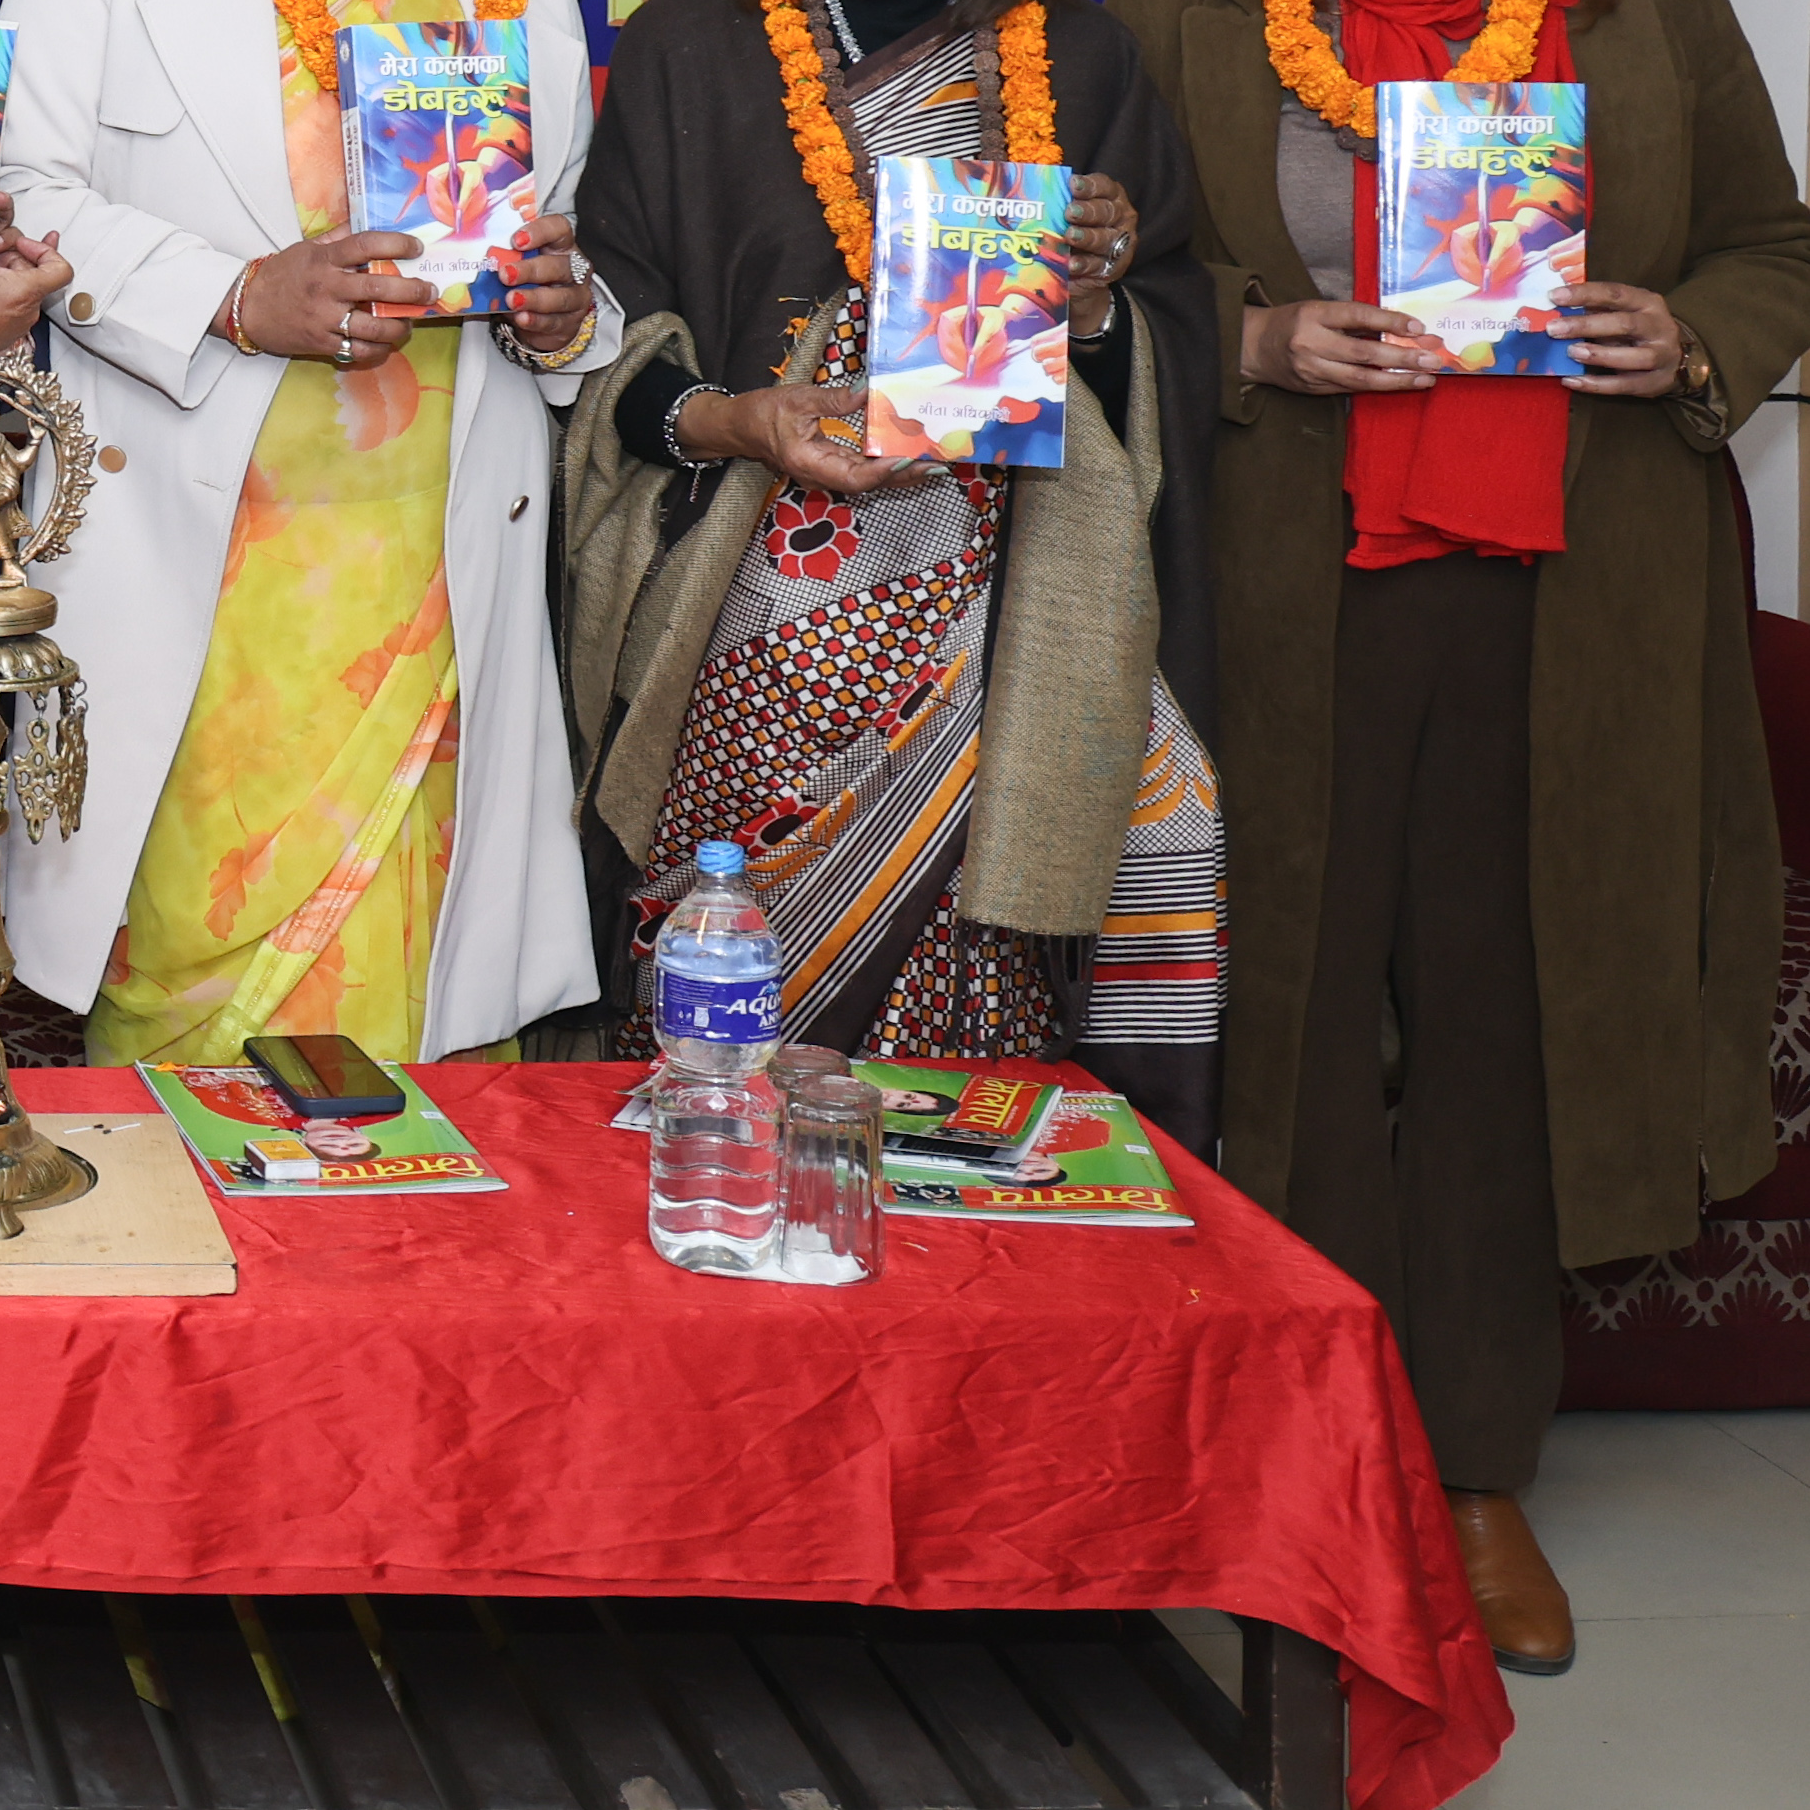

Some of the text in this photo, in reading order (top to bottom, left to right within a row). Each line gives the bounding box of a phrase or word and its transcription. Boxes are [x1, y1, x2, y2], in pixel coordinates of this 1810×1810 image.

[380, 52, 507, 77] मेरा कलमका
[383, 80, 509, 118] डोबहरू
[1457, 115, 1556, 136] कलमका
[1409, 140, 1556, 179] डोबहरू
[951, 193, 1045, 221] कलमका
[900, 218, 1044, 265] डोबहरू
[419, 258, 444, 272] गीता
[1436, 317, 1465, 331] गीता
[918, 403, 946, 417] गीता
[983, 1188, 1171, 1212] मिलाप
